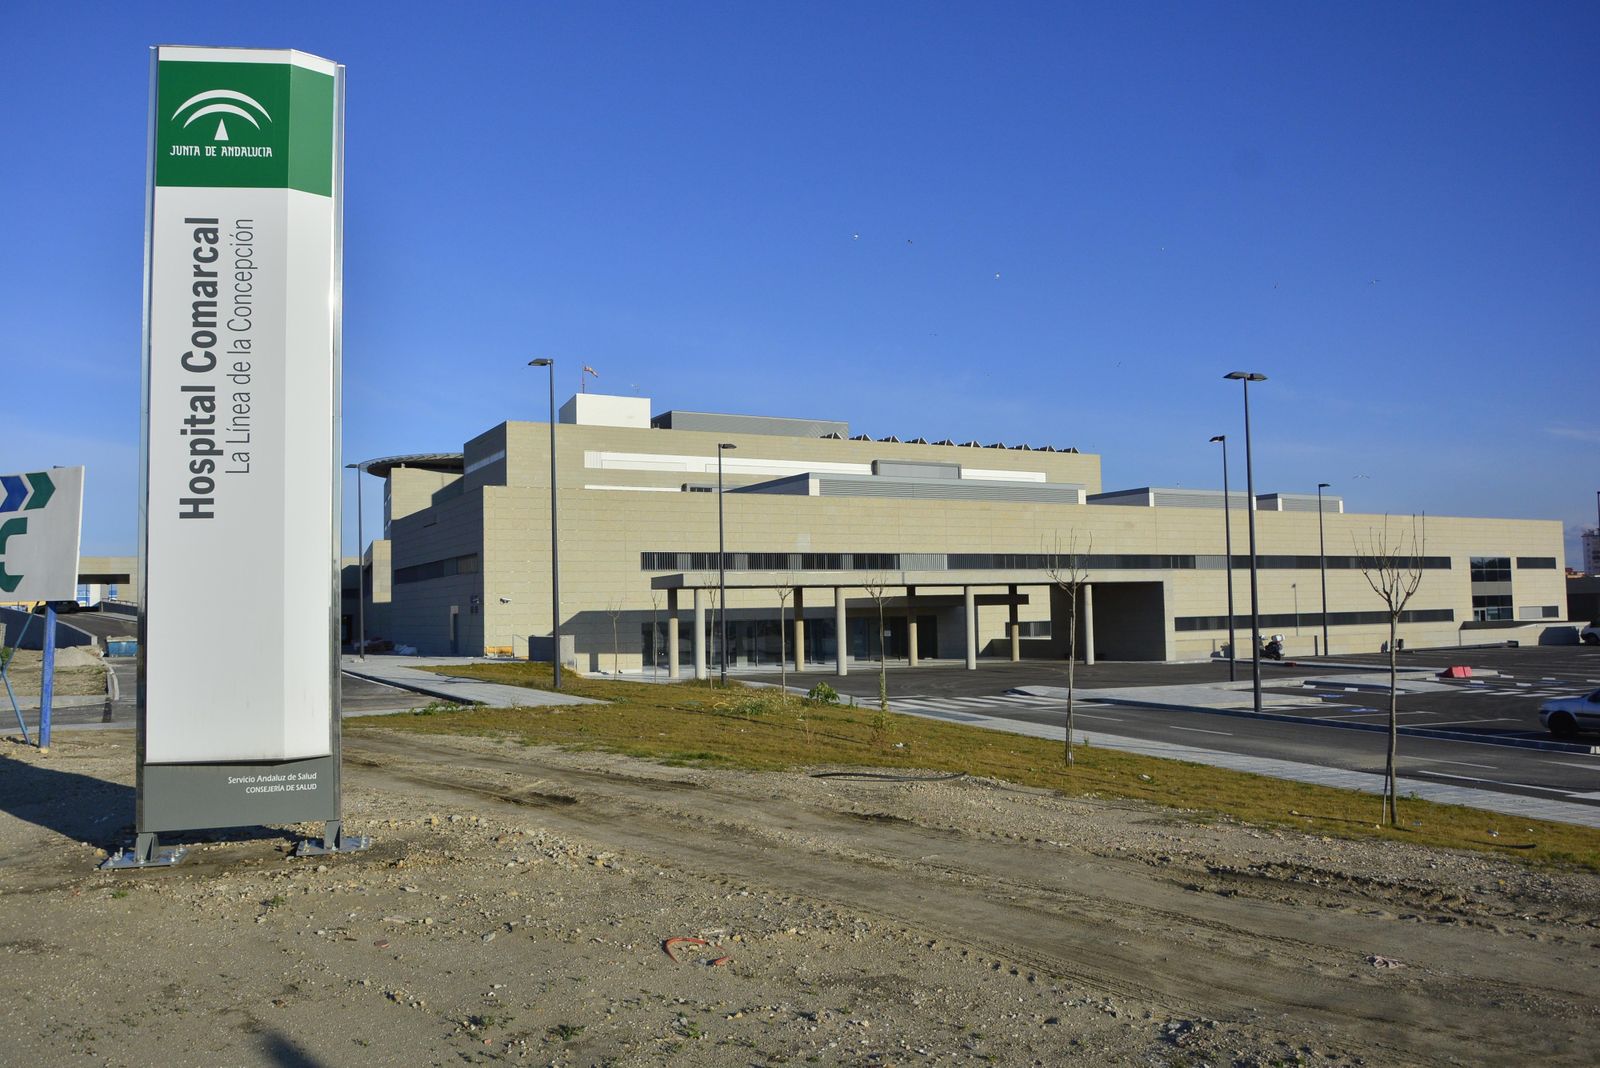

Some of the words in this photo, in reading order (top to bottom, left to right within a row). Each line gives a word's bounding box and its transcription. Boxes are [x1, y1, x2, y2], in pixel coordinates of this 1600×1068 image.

[170, 145, 200, 156] JUNTA
[205, 146, 217, 157] DE
[227, 219, 258, 332] Concepción
[181, 217, 219, 373] Comarcal
[227, 339, 252, 354] la
[226, 361, 251, 385] de
[225, 392, 251, 443] Línea
[179, 385, 224, 519] Hospital
[225, 451, 250, 473] La
[228, 775, 255, 784] Servicio
[256, 774, 286, 783] Andaluz
[287, 773, 296, 781] de
[297, 772, 317, 781] Salud
[296, 783, 317, 791] SALUD
